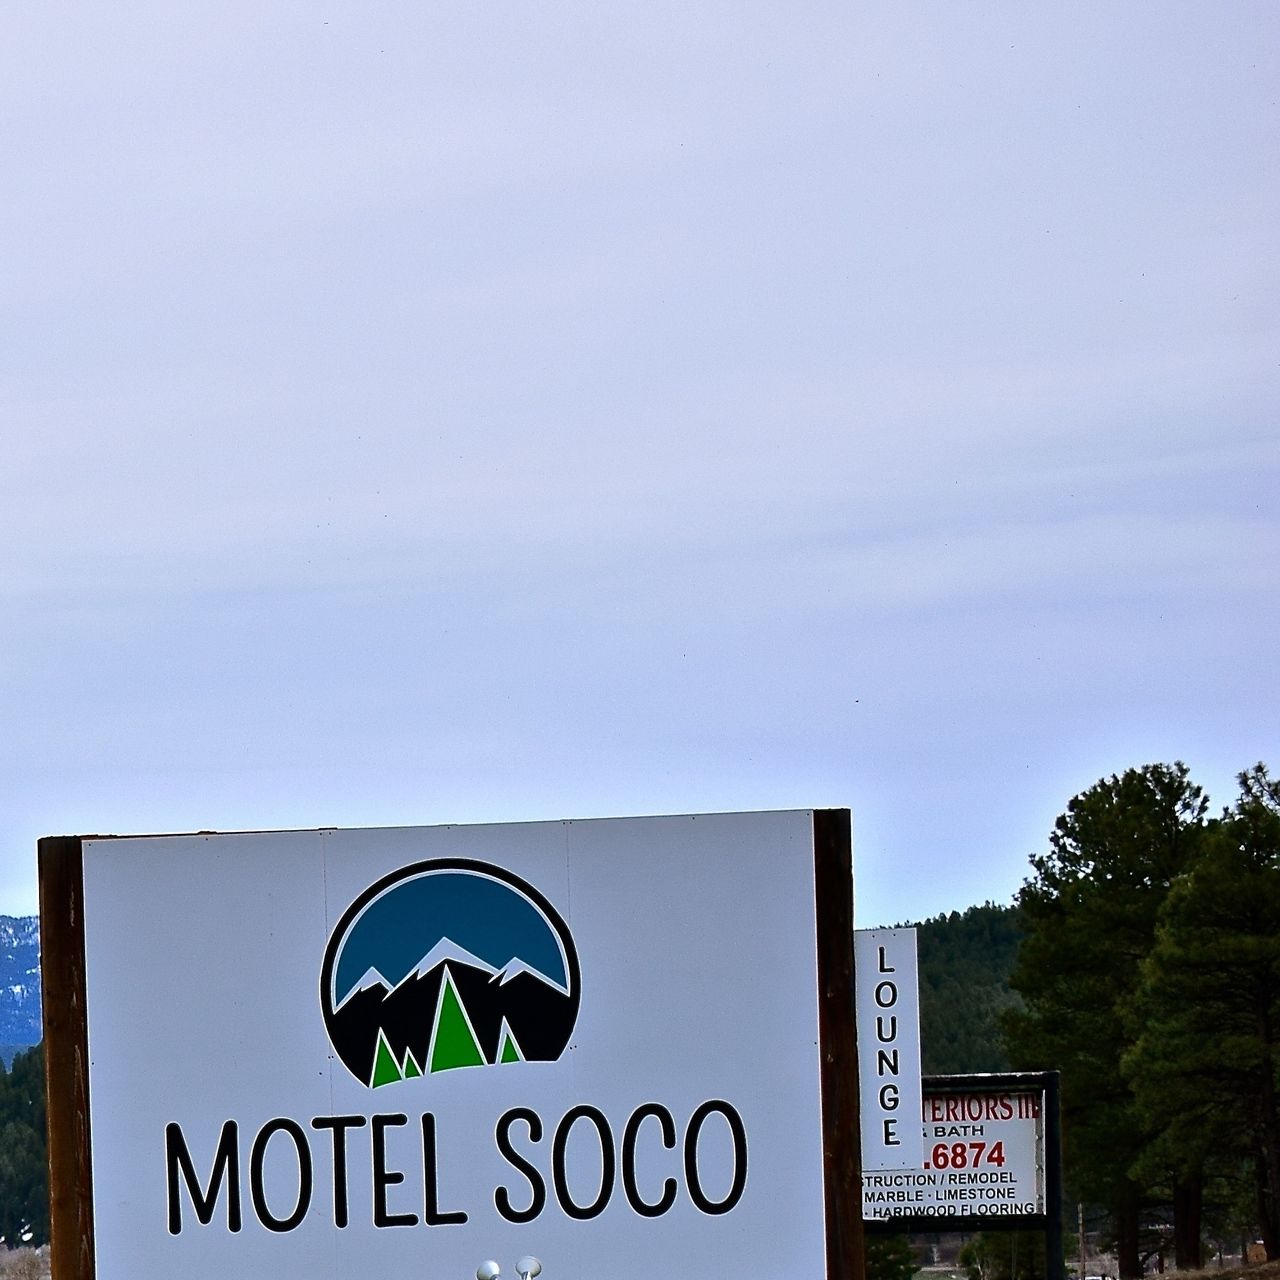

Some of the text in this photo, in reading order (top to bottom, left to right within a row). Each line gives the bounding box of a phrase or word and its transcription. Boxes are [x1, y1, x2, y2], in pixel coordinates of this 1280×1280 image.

[874, 945, 901, 1146] LOUNGE
[934, 1125, 984, 1138] BATH
[165, 1099, 749, 1236] MOTEL SOCO
[948, 1172, 1017, 1185] REMODEL
[864, 1187, 1016, 1203] MARBLE LIMESTONE
[872, 1203, 1035, 1218] HARDWOOD FLOORING
